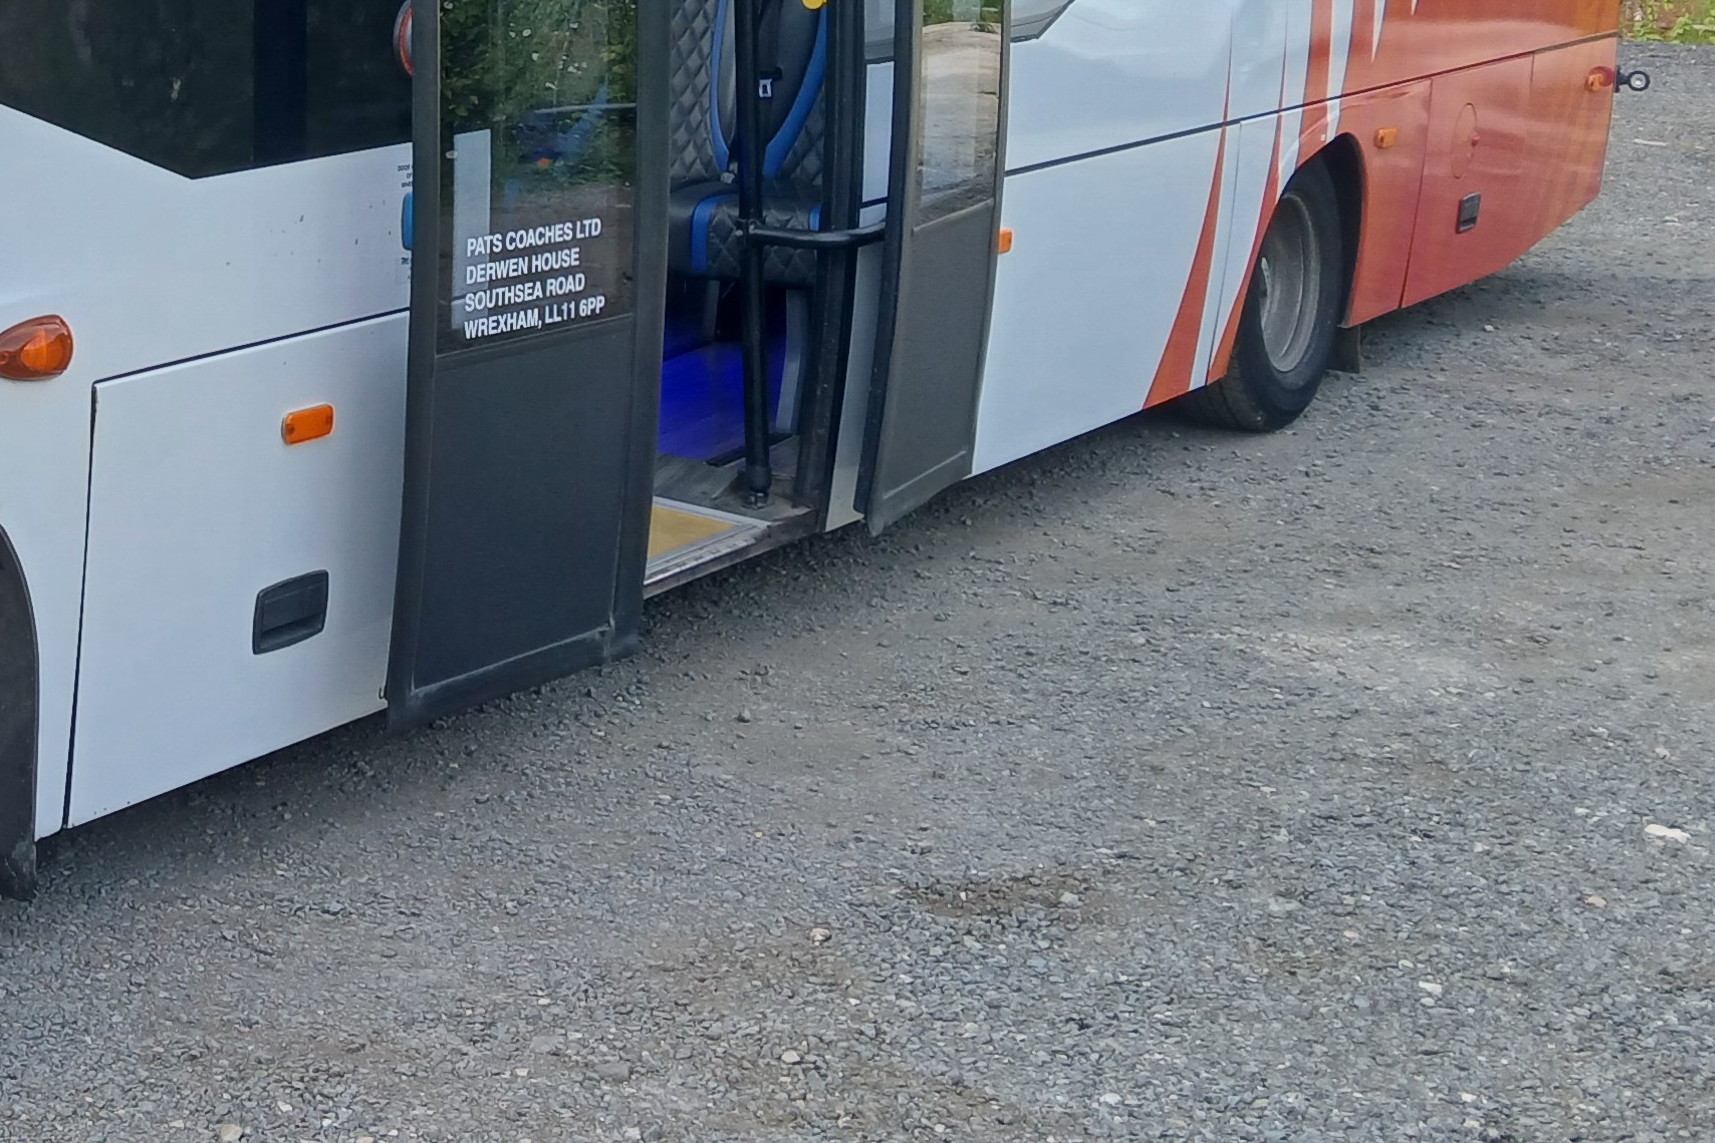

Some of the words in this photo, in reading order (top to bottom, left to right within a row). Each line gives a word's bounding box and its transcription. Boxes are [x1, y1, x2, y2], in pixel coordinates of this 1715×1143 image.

[466, 233, 503, 257] PATS
[505, 222, 573, 251] COACHES
[576, 218, 602, 239] LTD
[466, 256, 529, 285] DERWEN
[531, 247, 580, 273] HOUSE
[464, 281, 543, 312] SOUTHSEA
[546, 273, 585, 297] ROAD
[464, 308, 542, 340] WREXHAM,
[544, 301, 576, 324] LL11
[579, 295, 606, 317] 6PP
